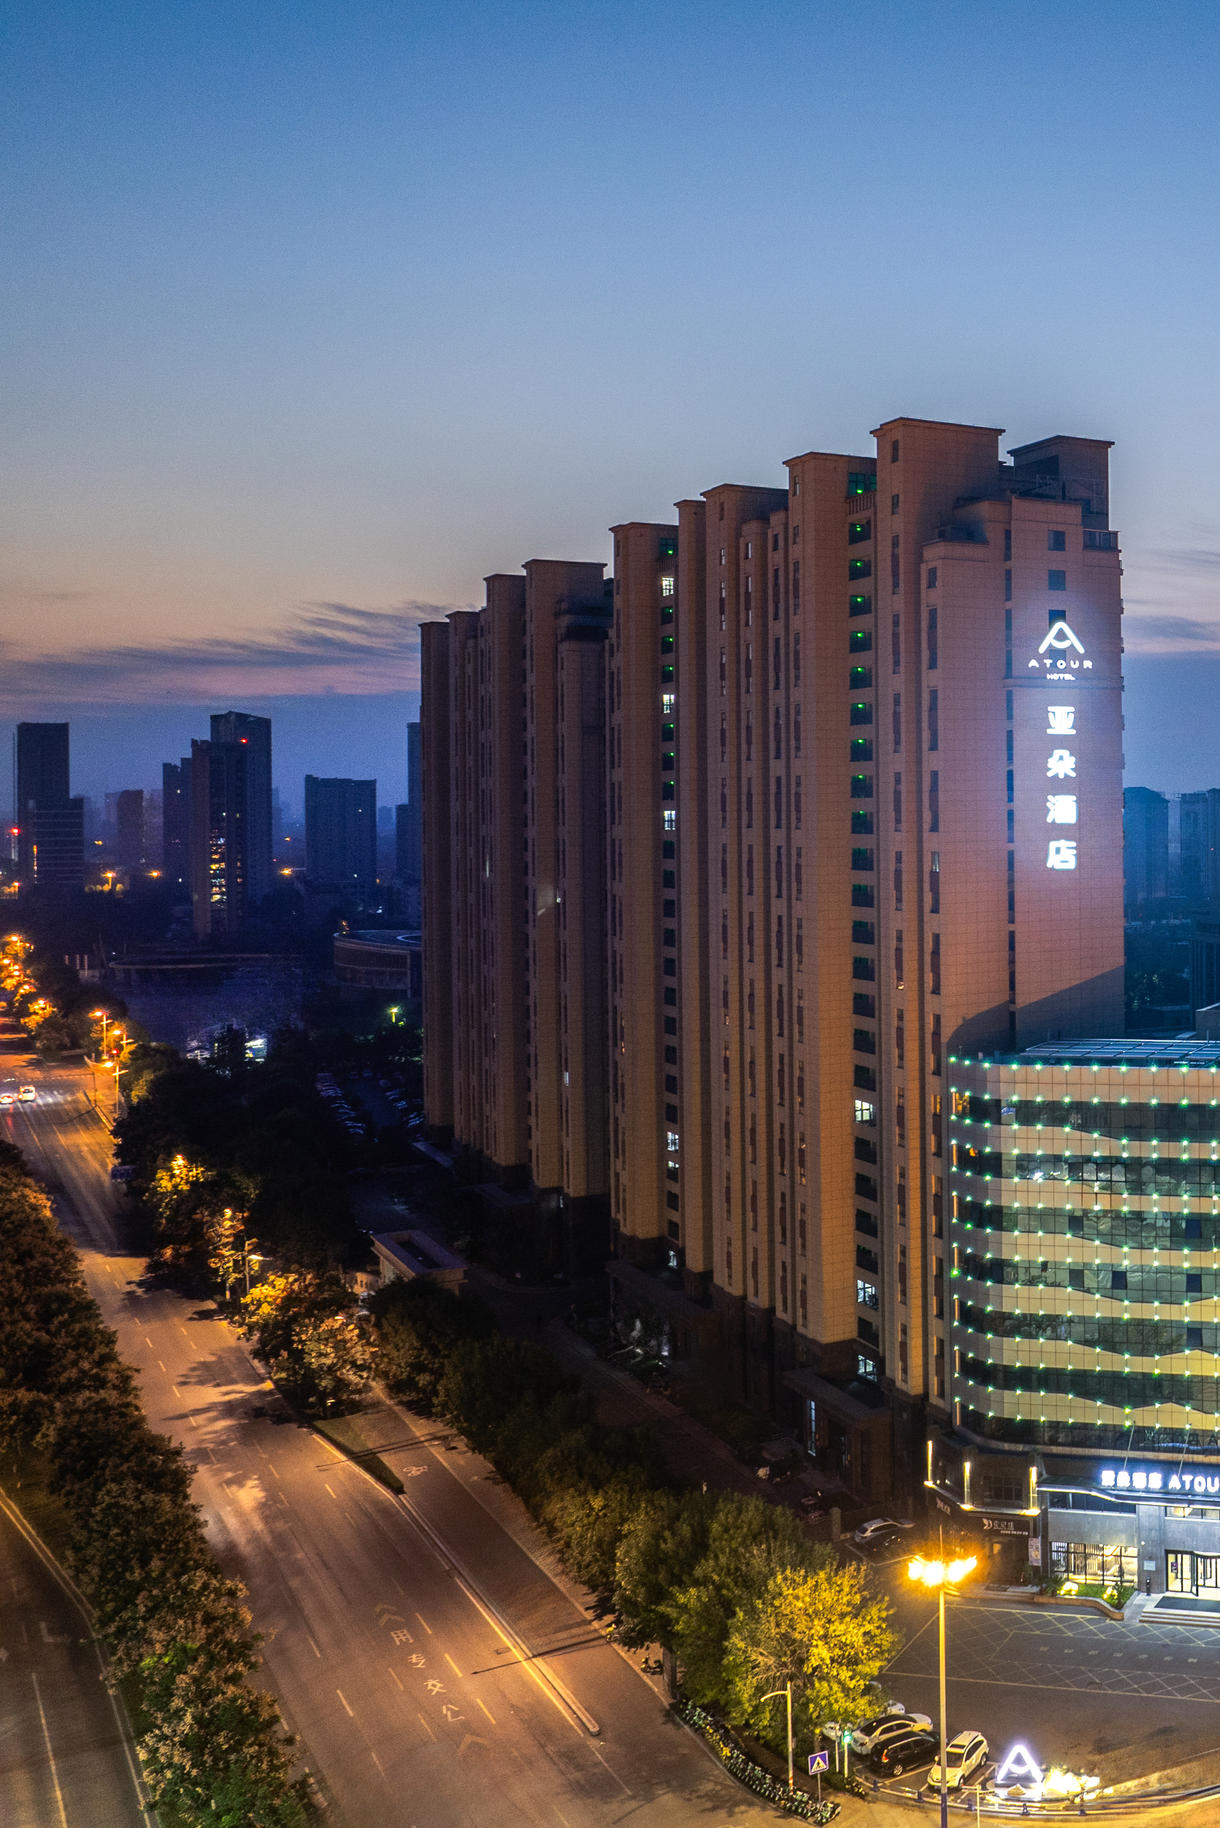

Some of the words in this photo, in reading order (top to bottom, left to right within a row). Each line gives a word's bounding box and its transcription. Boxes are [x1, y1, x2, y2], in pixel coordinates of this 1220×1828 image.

[1028, 658, 1093, 669] ATOUR
[1046, 705, 1078, 870] 亚朵酒店
